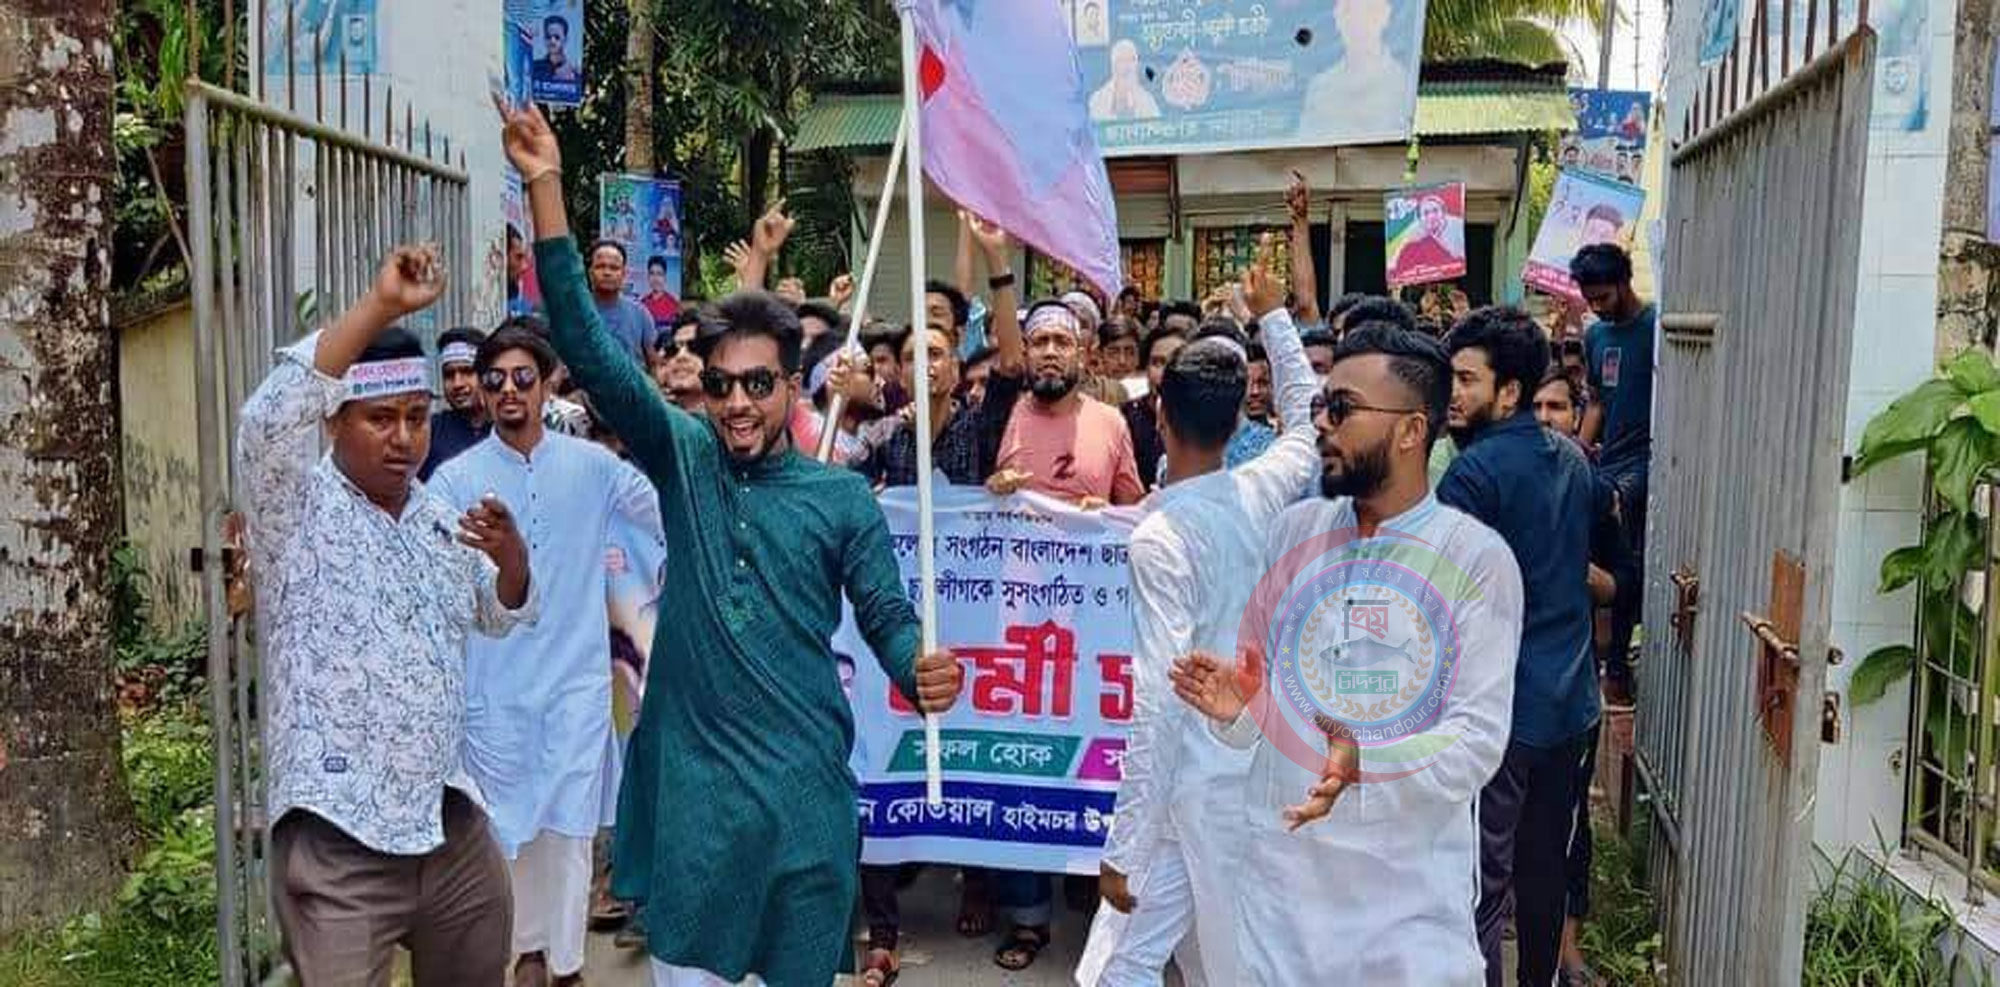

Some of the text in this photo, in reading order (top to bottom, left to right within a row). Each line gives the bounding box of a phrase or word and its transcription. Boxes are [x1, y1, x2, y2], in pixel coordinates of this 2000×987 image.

[945, 527, 1004, 560] সংগঠন
[1010, 538, 1092, 566] বাংলাদেশ
[1001, 574, 1083, 611] সুসংগঠিত
[1093, 586, 1108, 608] ও
[990, 741, 1054, 769] হোক
[1002, 801, 1077, 831] হাইমচর
